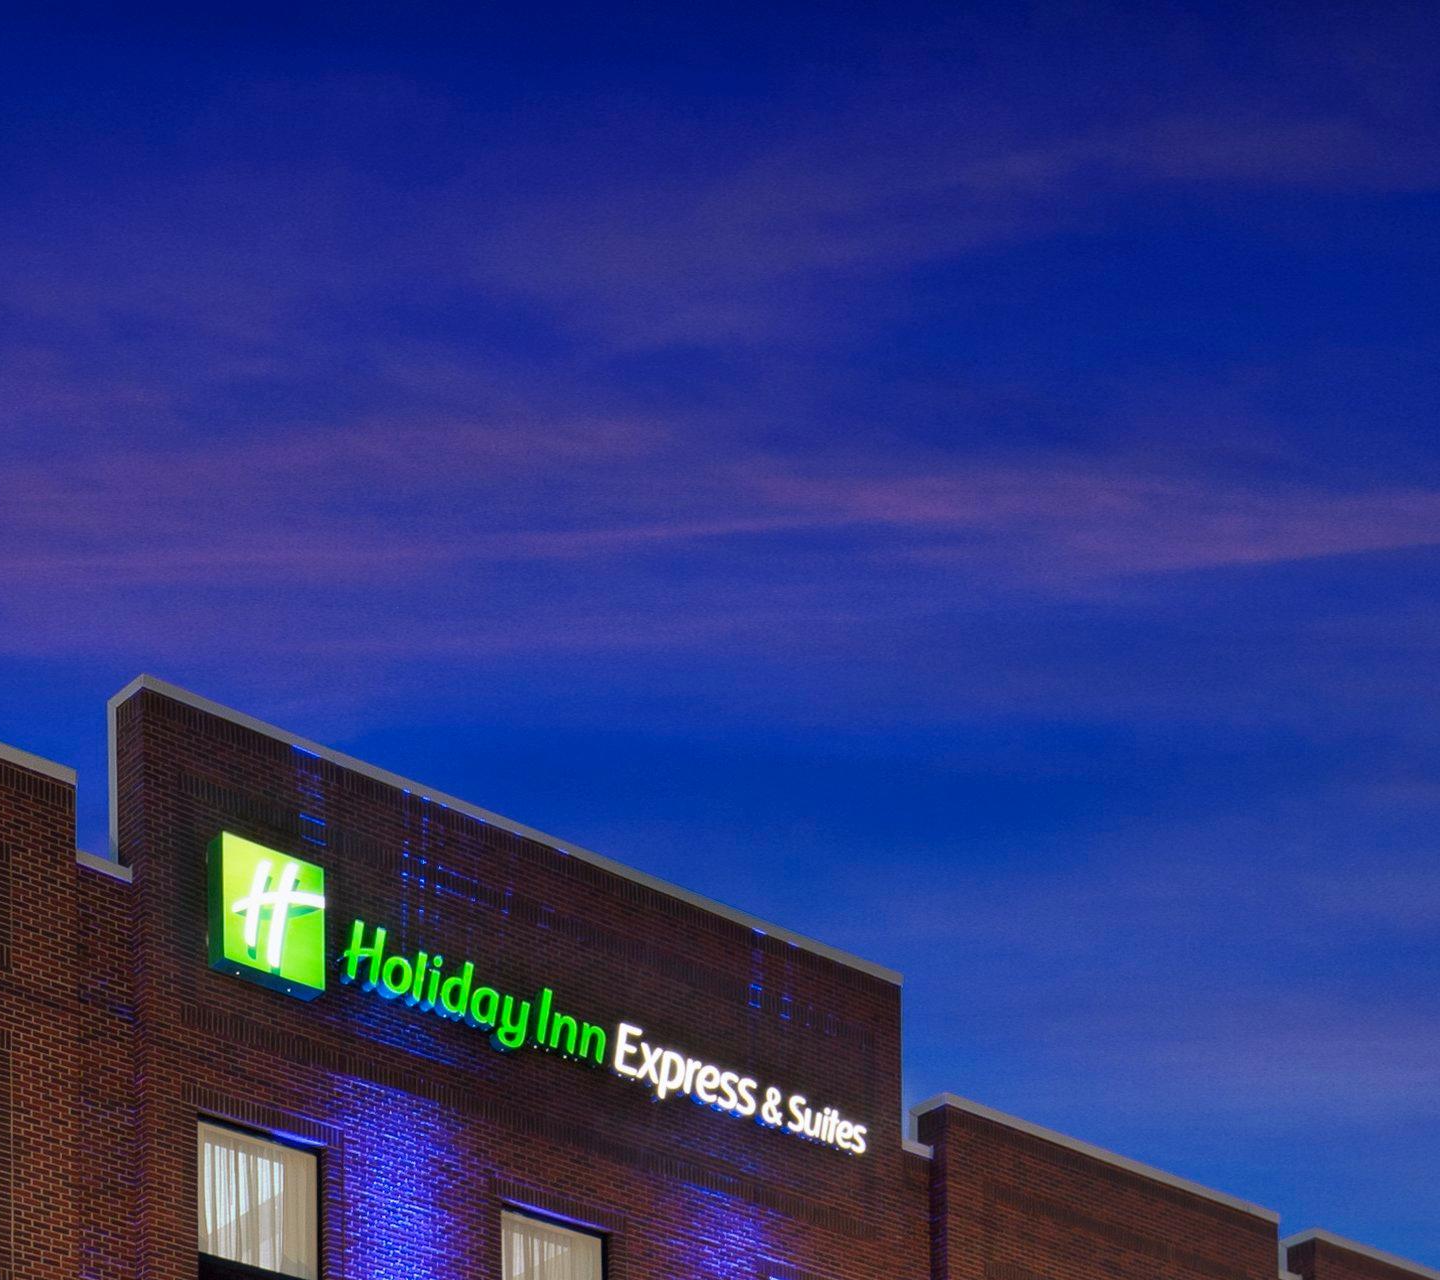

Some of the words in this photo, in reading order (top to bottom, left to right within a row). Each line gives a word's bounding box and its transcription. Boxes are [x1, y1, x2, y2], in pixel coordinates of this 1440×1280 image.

[344, 920, 530, 1049] Holiday
[535, 988, 607, 1065] Inn
[614, 1022, 757, 1117] Express
[761, 1086, 782, 1127] &
[787, 1094, 867, 1155] Suites
